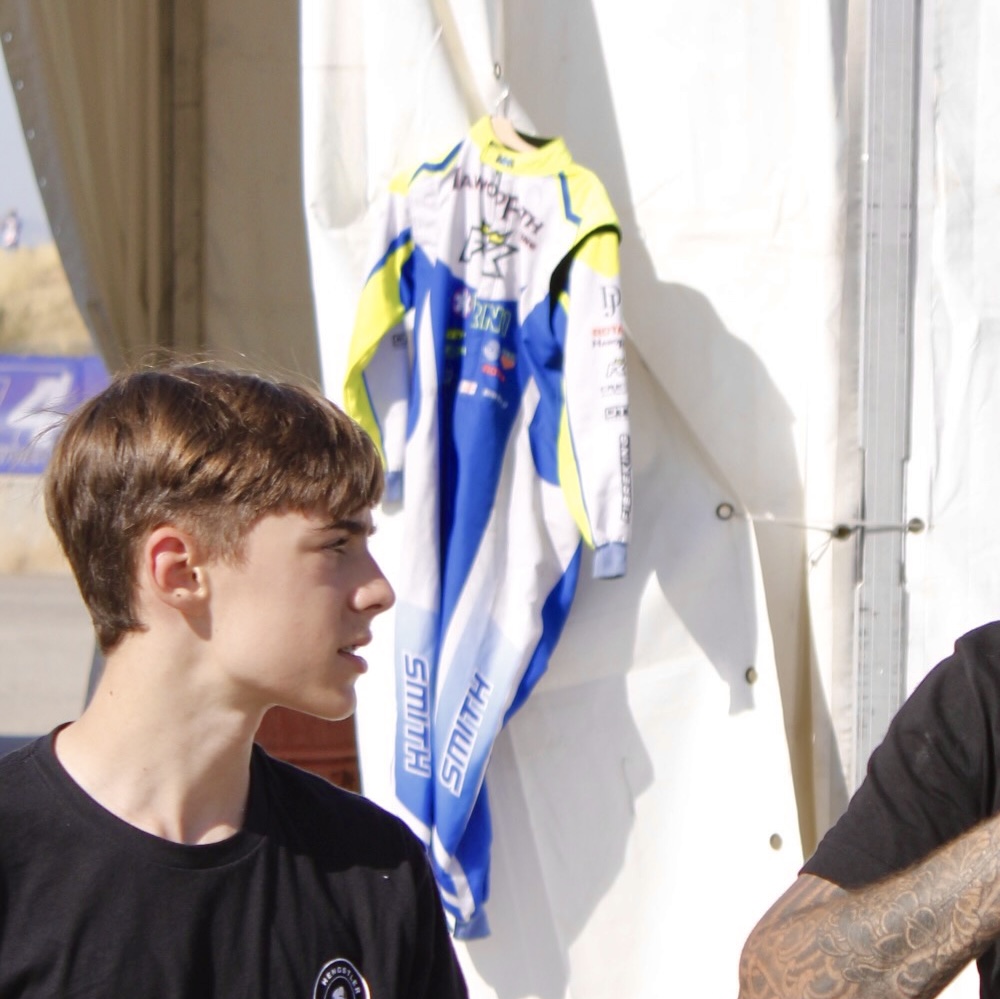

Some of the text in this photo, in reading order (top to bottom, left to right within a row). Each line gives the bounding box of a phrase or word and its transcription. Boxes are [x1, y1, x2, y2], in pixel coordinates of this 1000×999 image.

[404, 653, 432, 778] SMITH
[441, 672, 493, 797] SMITH
[320, 966, 361, 995] HENGSTLER
